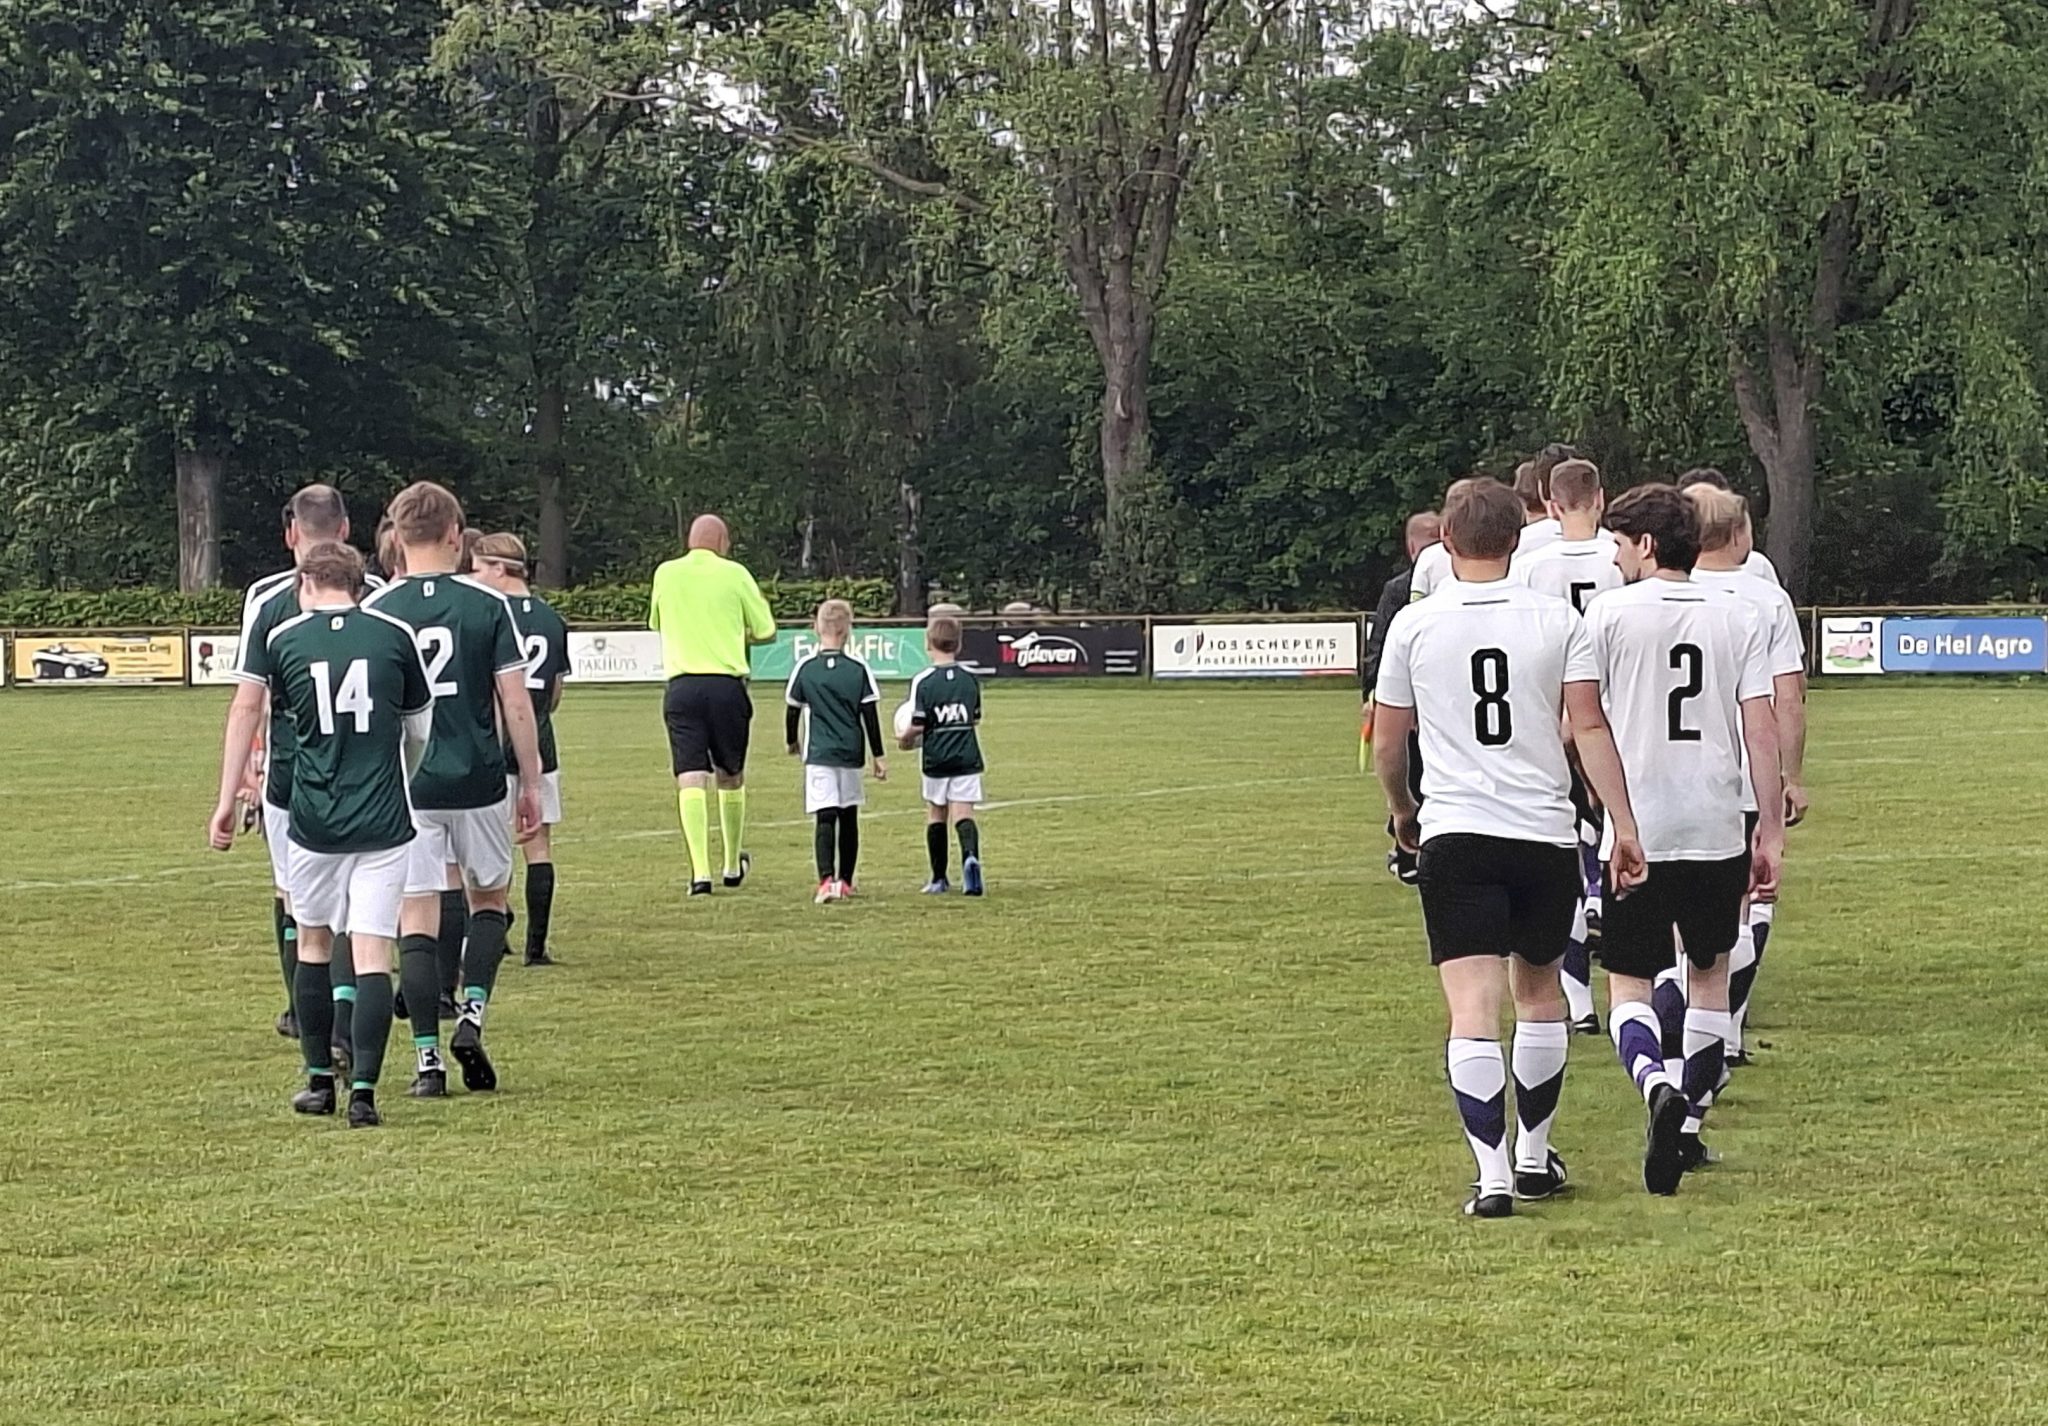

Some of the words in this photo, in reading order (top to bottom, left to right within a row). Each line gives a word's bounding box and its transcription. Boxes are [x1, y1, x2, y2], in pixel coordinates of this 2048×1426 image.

[416, 626, 458, 697] 2
[1245, 638, 1337, 650] SCHEPERS
[1899, 634, 1929, 655] De
[1935, 634, 1972, 655] Hel
[1977, 634, 2033, 660] Agro
[309, 658, 374, 735] 14
[1470, 647, 1512, 746] 8
[1668, 643, 1703, 741] 2
